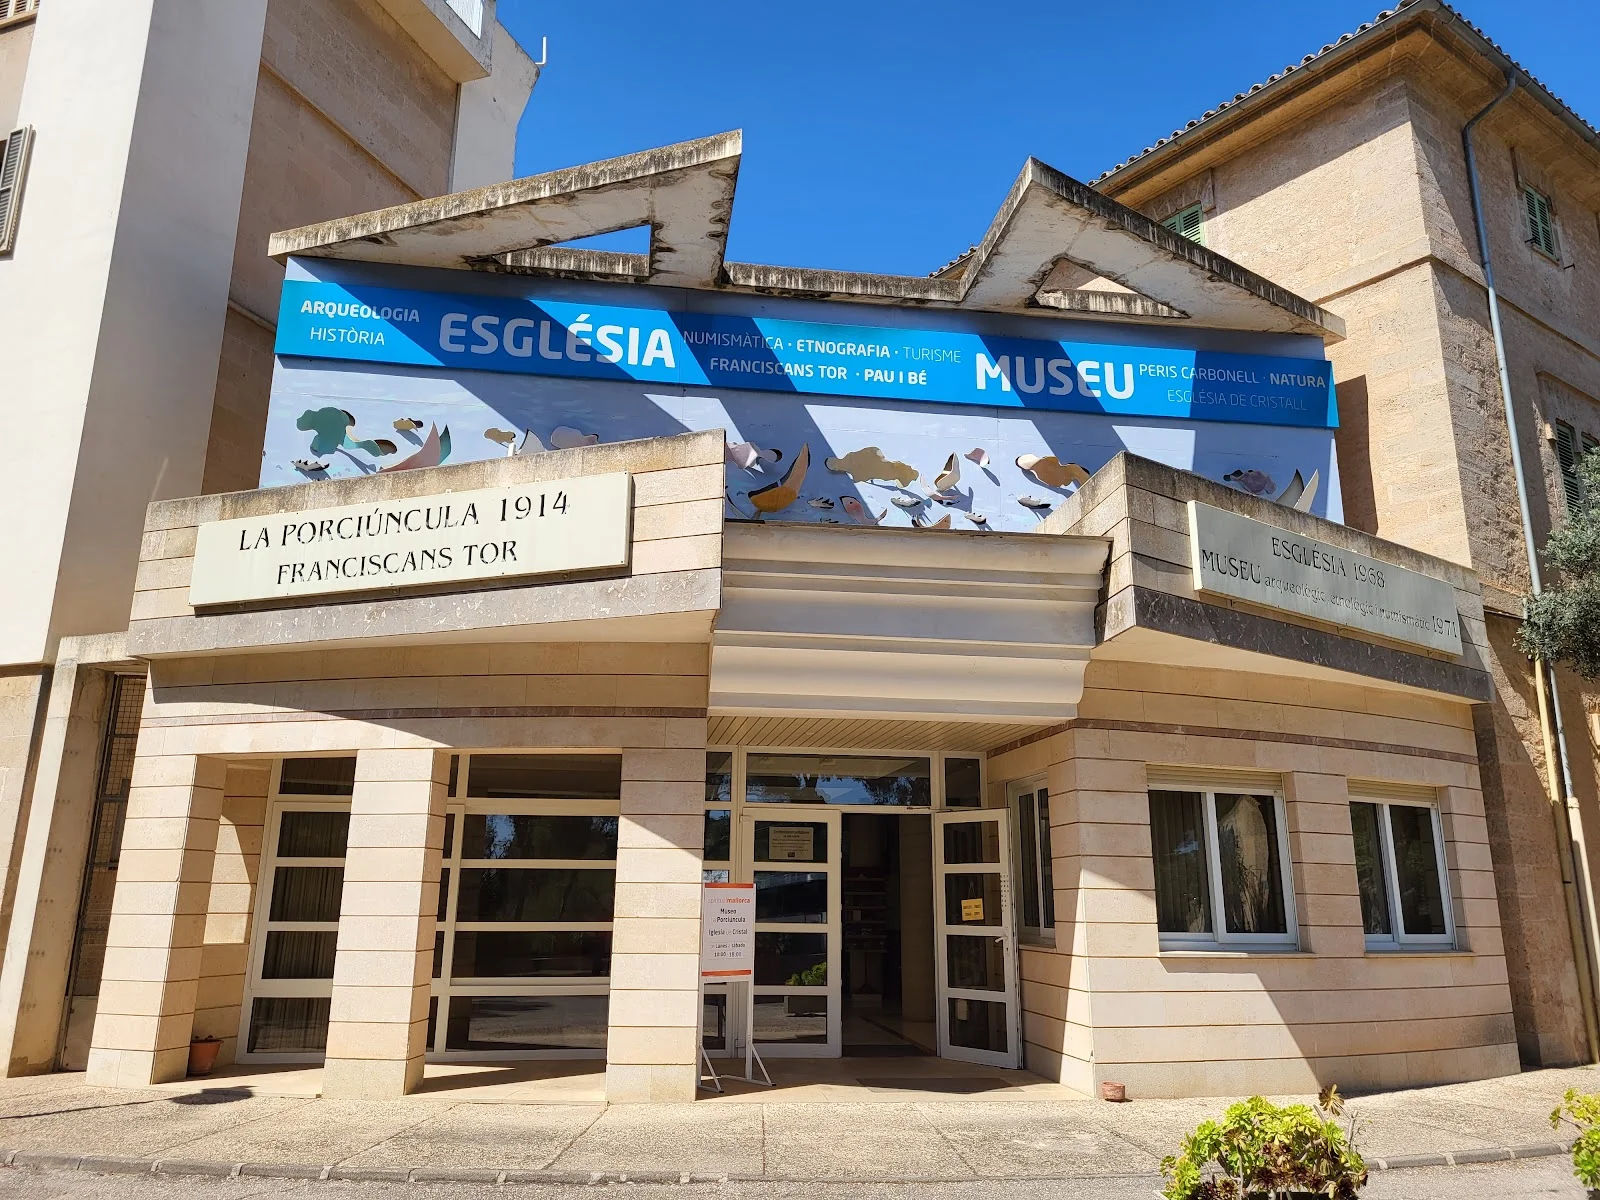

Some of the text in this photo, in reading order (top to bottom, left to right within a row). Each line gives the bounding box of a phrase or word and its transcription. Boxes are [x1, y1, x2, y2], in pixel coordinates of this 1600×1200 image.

[301, 299, 420, 322] ARQUEOLOGIA
[310, 326, 386, 346] HISTÒRIA
[438, 313, 676, 368] ESGLÉSIA
[683, 330, 962, 363] NUMISMÀTICA ETNOGRAFIA TURISME
[709, 357, 928, 386] FRANCISCANS TOR PAU I BÉ
[975, 352, 1135, 400] MUSEU
[1139, 364, 1327, 389] PERIS CARBONELL NATURA
[1167, 389, 1308, 411] ESGLÉSIA DE CRISTALL
[239, 490, 571, 552] LA PORCIÚNCULA 1914
[277, 540, 518, 585] FRANCISCANS TOR
[1271, 537, 1386, 588] ESGLÉSIA 1968
[1201, 549, 1261, 584] MUSEU
[1432, 615, 1458, 638] 1971
